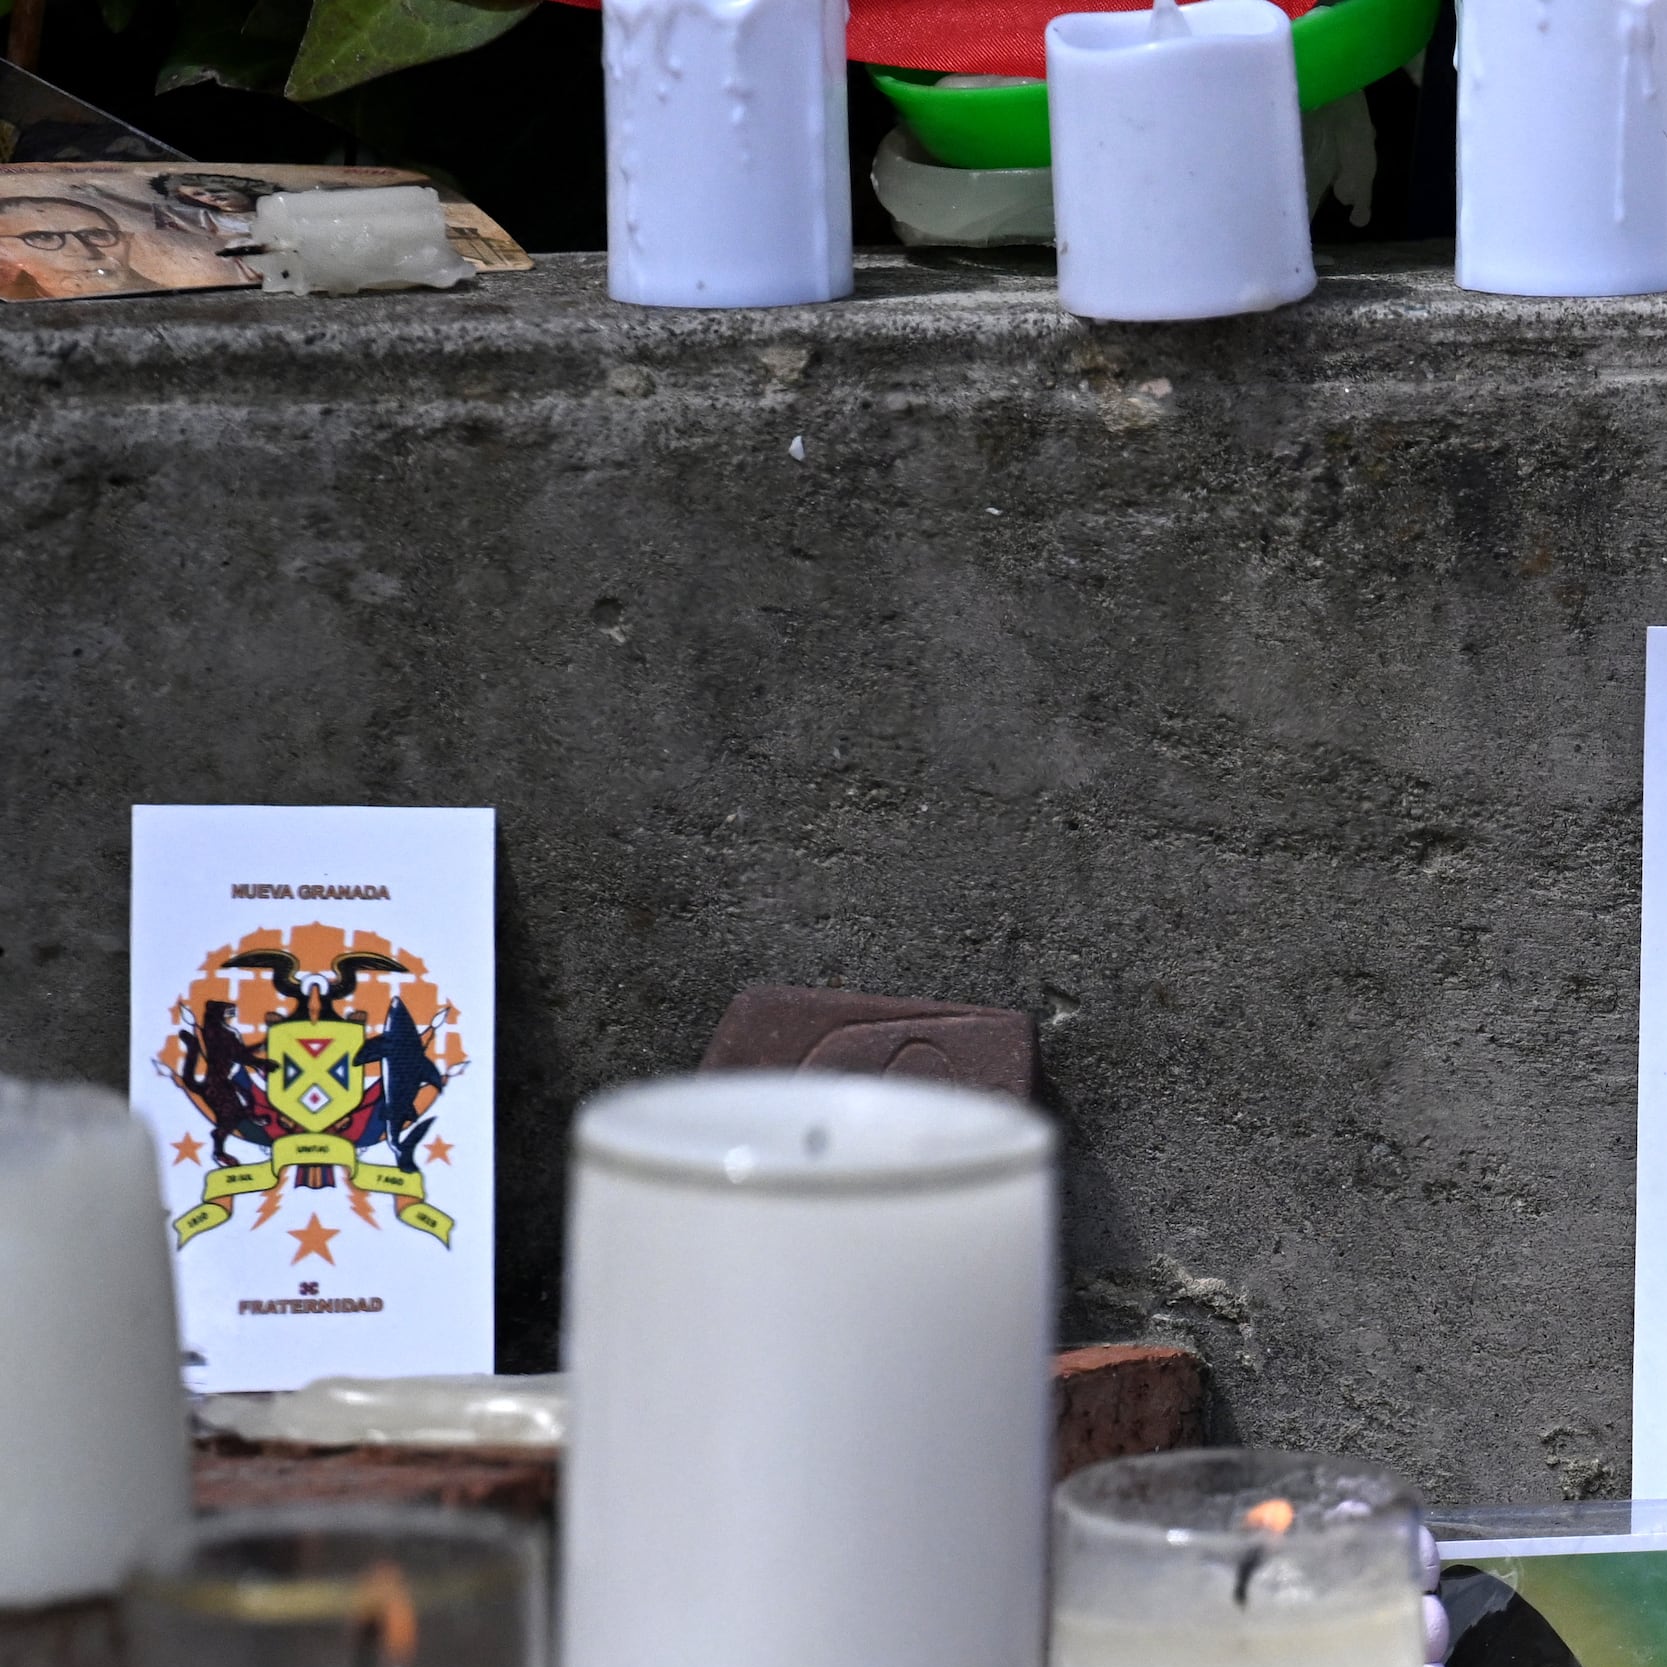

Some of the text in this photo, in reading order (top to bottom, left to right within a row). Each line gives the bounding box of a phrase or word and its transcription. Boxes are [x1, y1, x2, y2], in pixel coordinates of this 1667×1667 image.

[231, 883, 391, 900] NUEVA GRANADA
[238, 1297, 384, 1315] FRATERNIDAD
